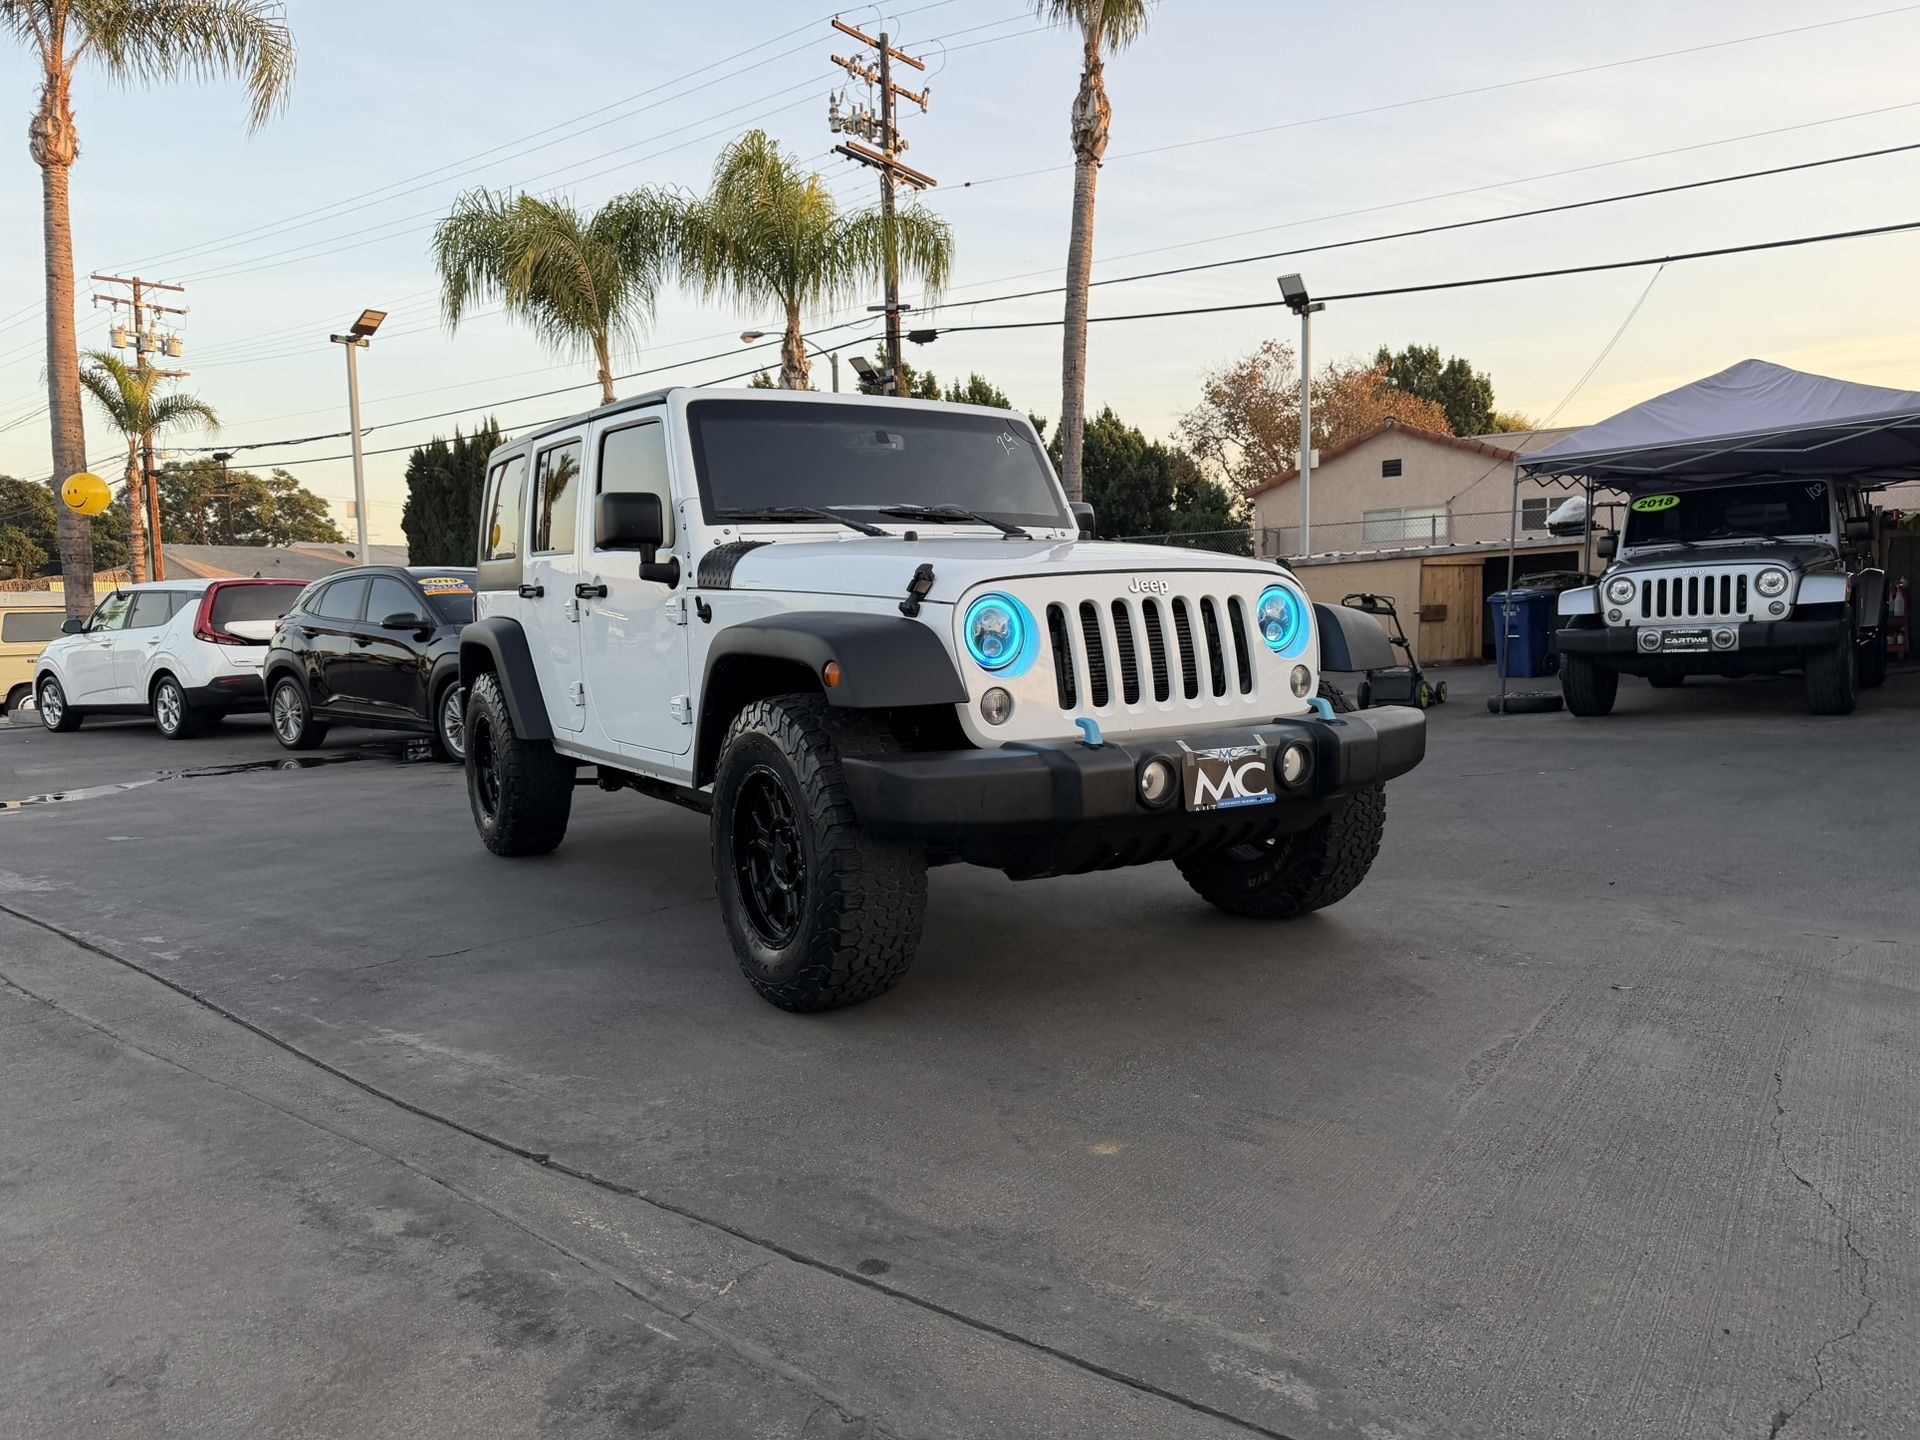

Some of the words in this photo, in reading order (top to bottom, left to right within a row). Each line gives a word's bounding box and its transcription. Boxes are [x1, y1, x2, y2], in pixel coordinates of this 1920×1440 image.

[1638, 497, 1674, 509] 2018
[1128, 577, 1169, 595] Jeep
[1219, 747, 1238, 758] MC
[1194, 761, 1269, 805] MC
